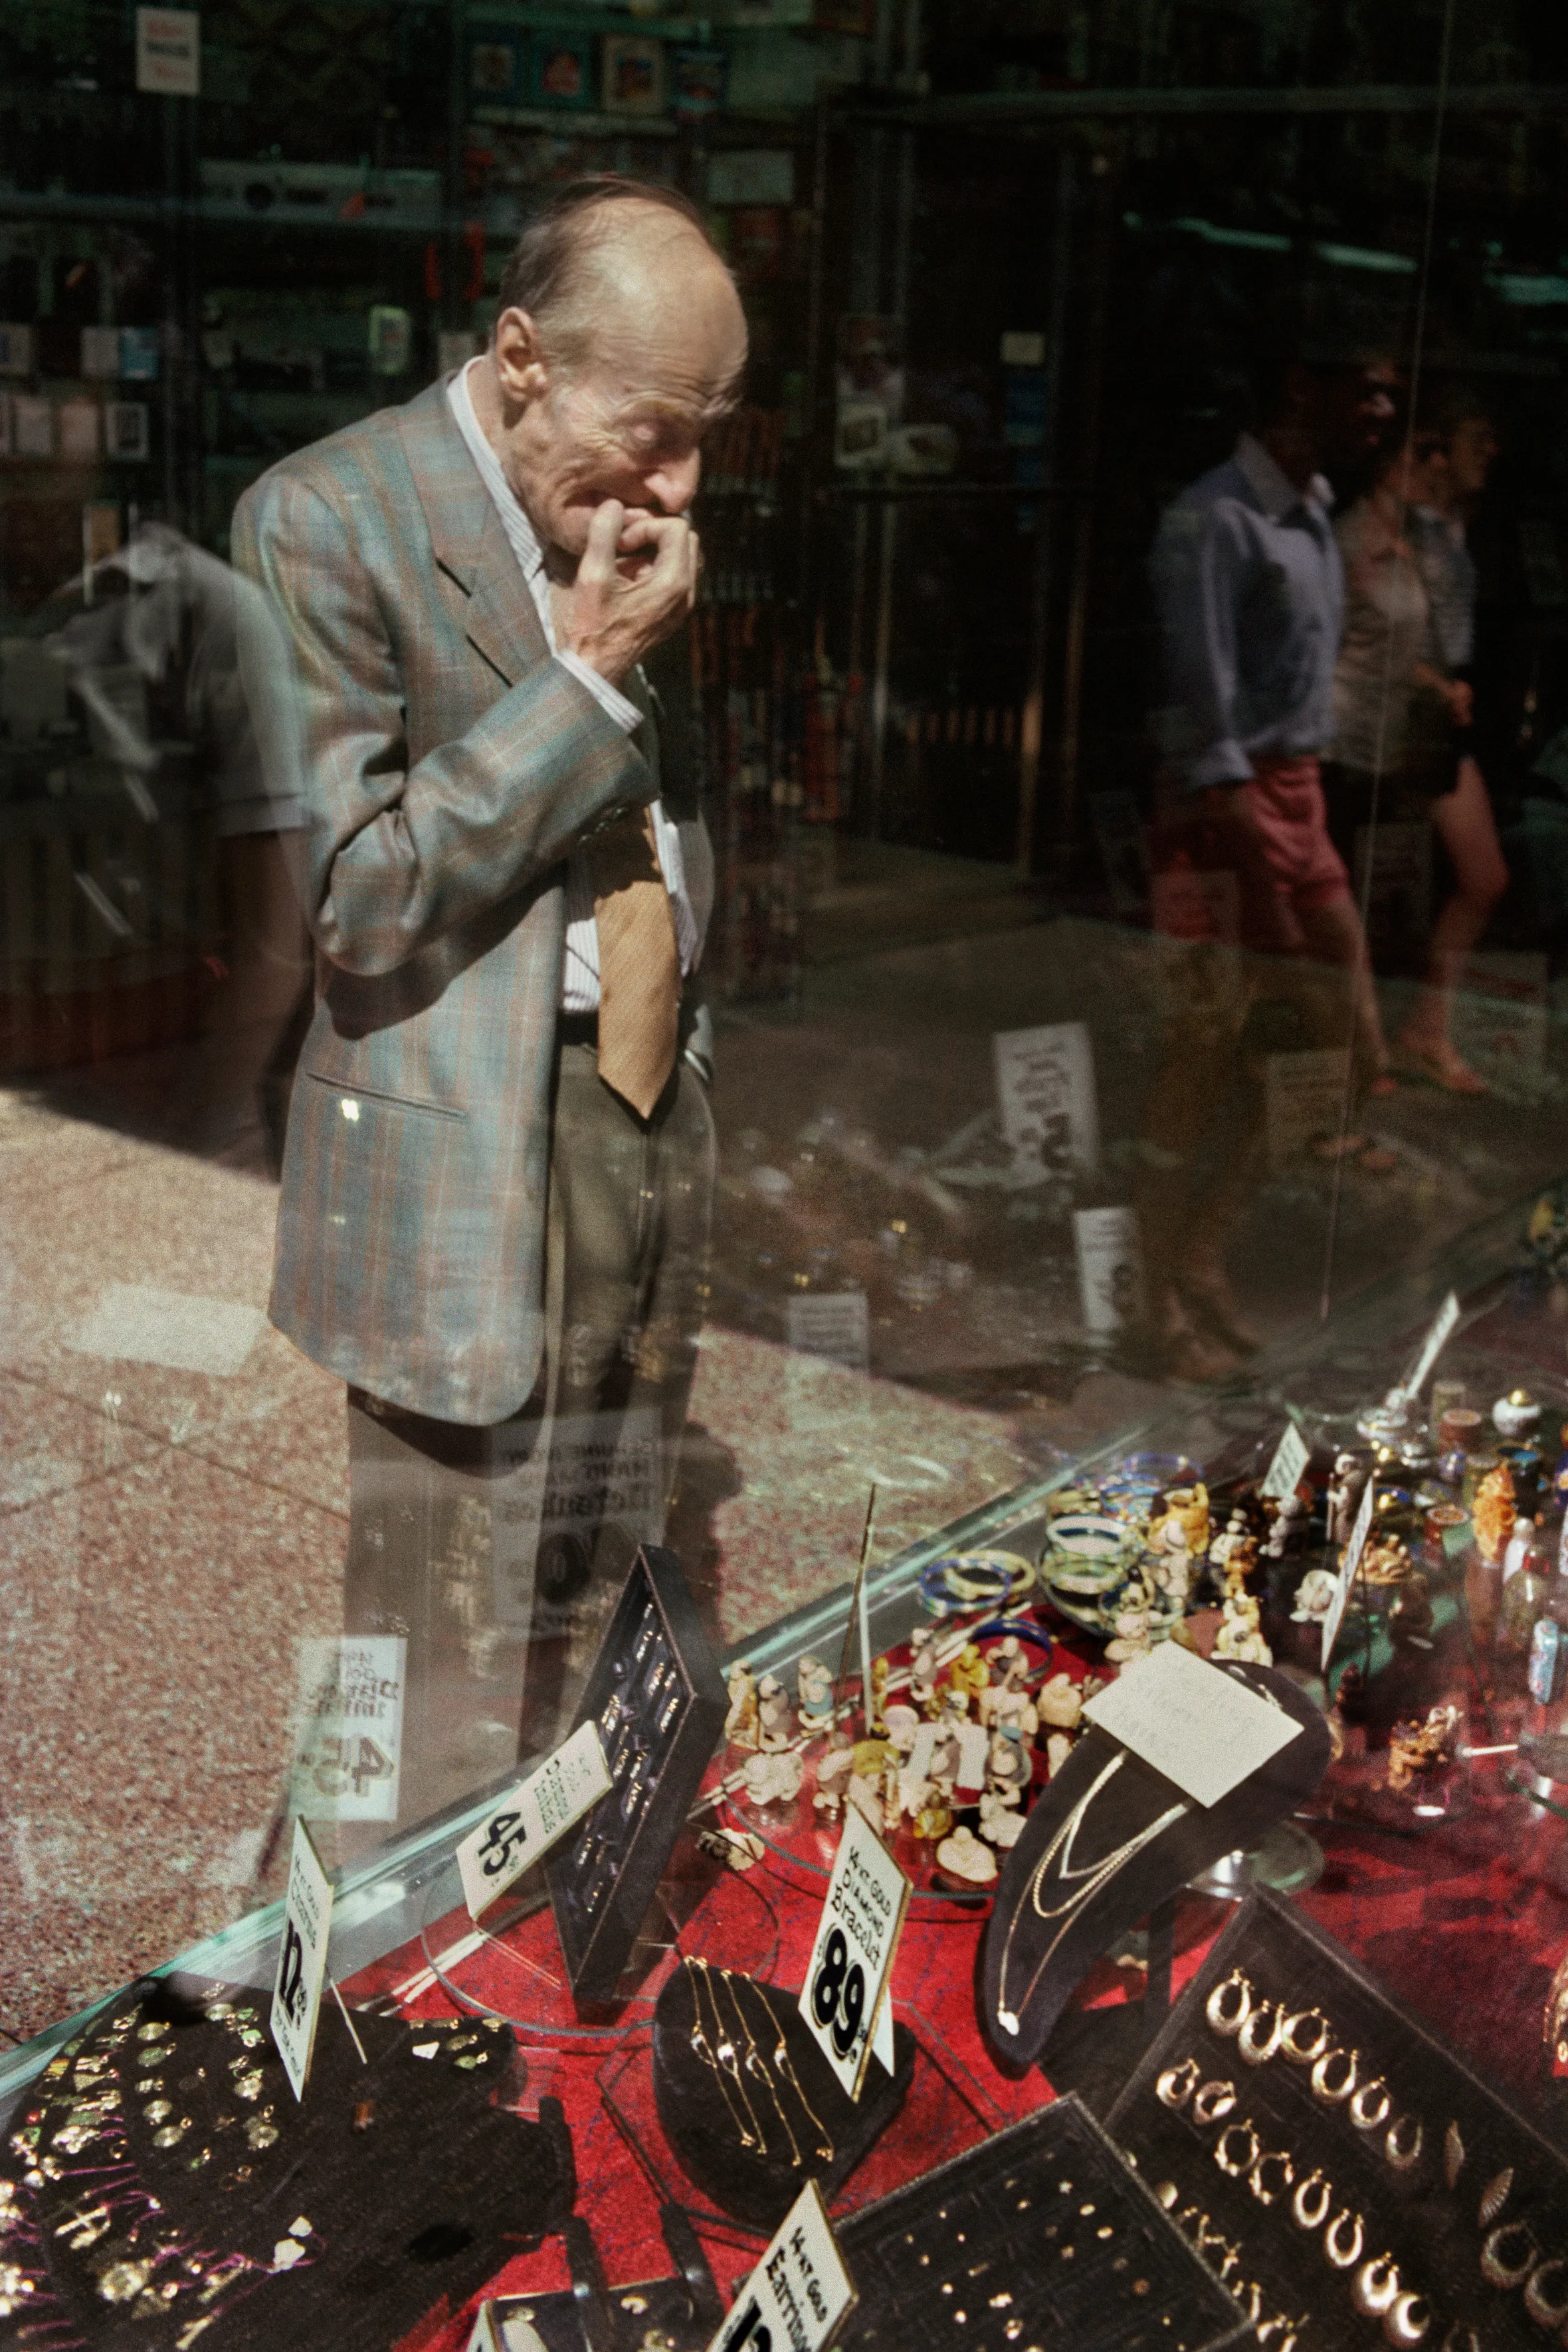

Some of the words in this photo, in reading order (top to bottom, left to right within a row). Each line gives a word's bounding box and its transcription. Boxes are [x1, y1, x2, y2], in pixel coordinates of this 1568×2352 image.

[477, 1812, 526, 1875] 45
[831, 1882, 881, 1972] Bracelet
[842, 1867, 884, 1939] DIAMOND
[870, 1879, 891, 1917] GOLD
[279, 1917, 303, 2022] 12
[811, 1924, 865, 2060] 89
[806, 2278, 829, 2323] GOLD
